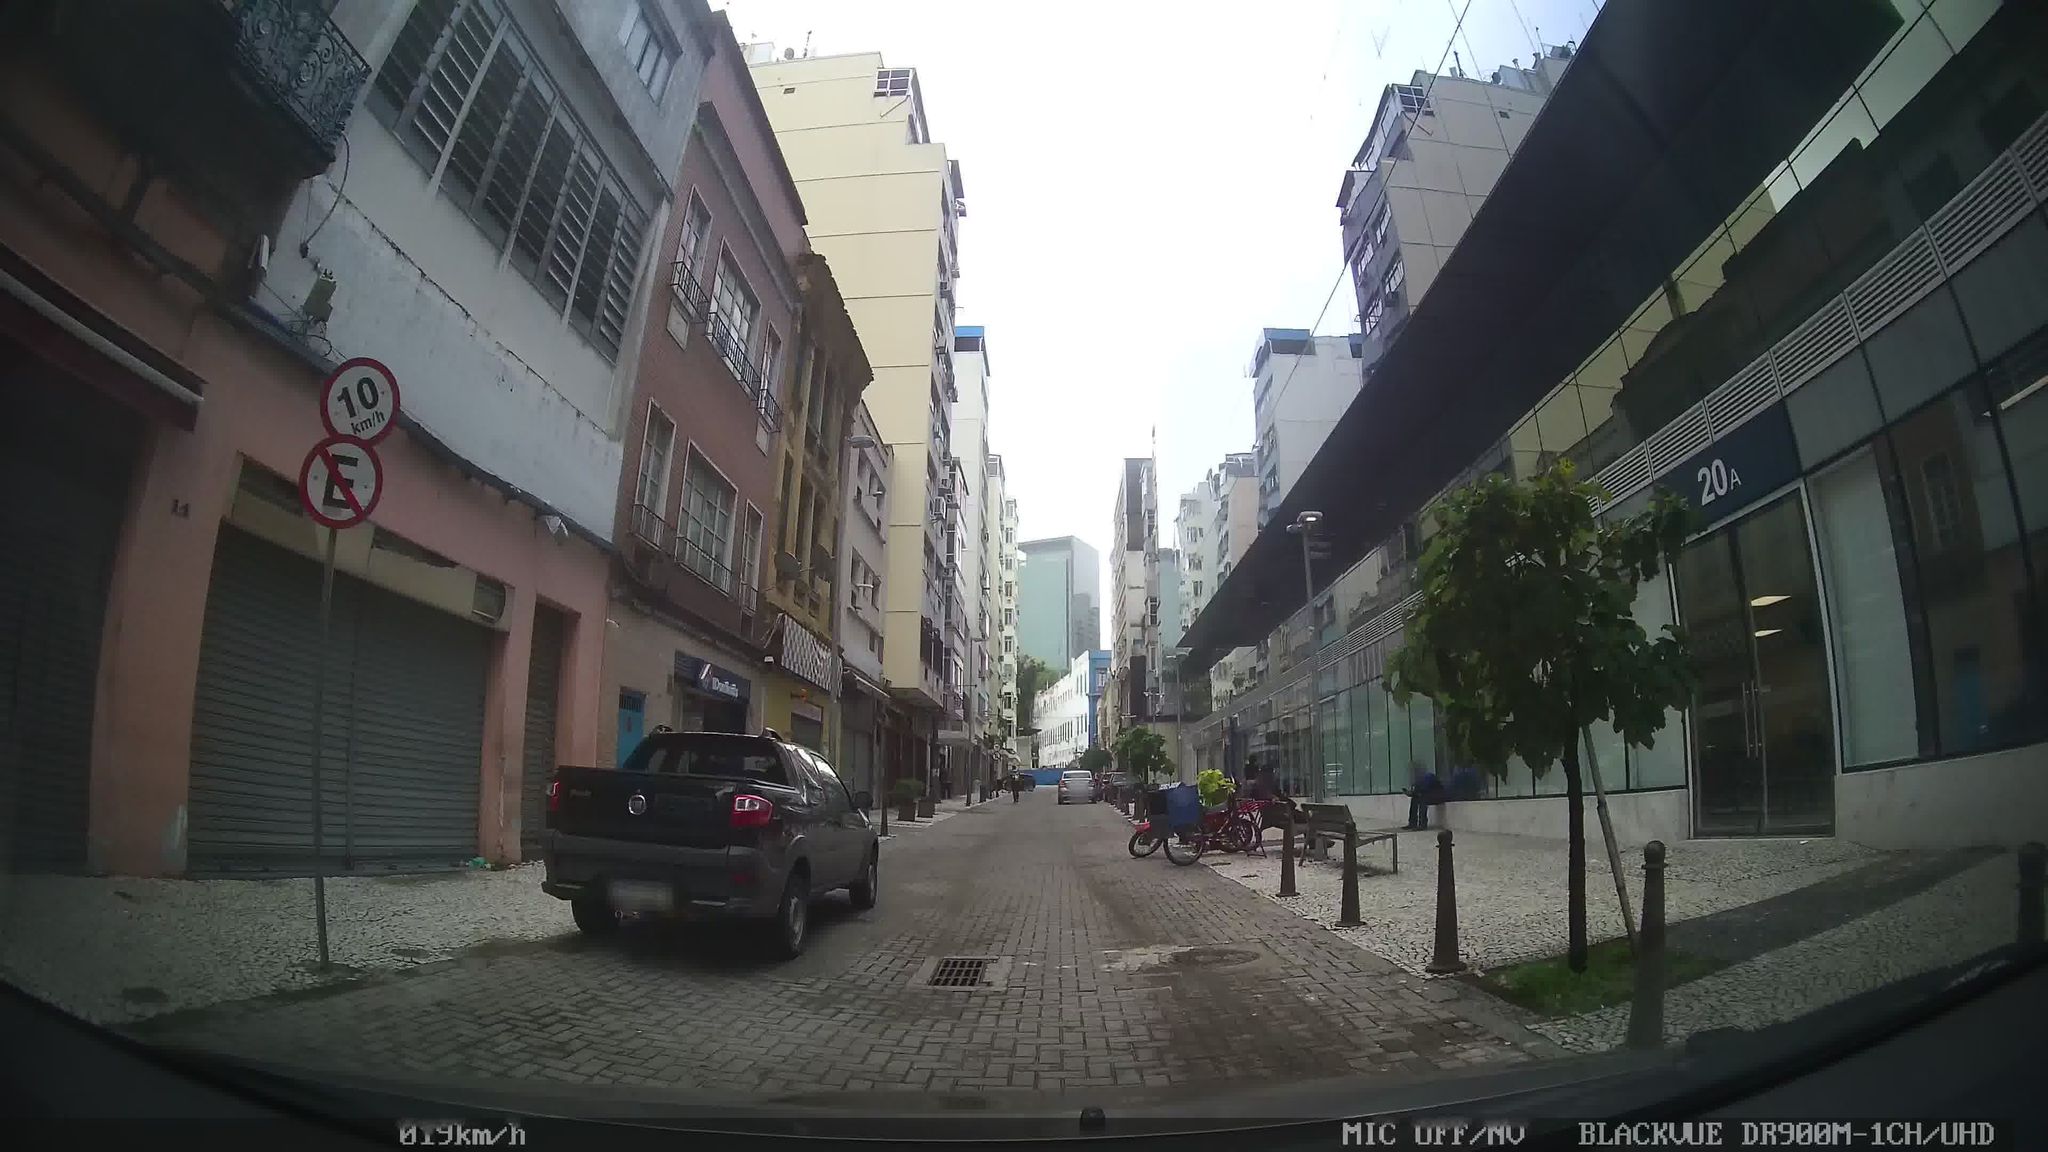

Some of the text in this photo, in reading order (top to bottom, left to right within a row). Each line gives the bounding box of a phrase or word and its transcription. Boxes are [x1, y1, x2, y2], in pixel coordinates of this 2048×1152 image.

[337, 376, 379, 419] 10
[351, 410, 386, 435] km/h
[322, 454, 358, 510] E
[1697, 459, 1742, 506] 20A
